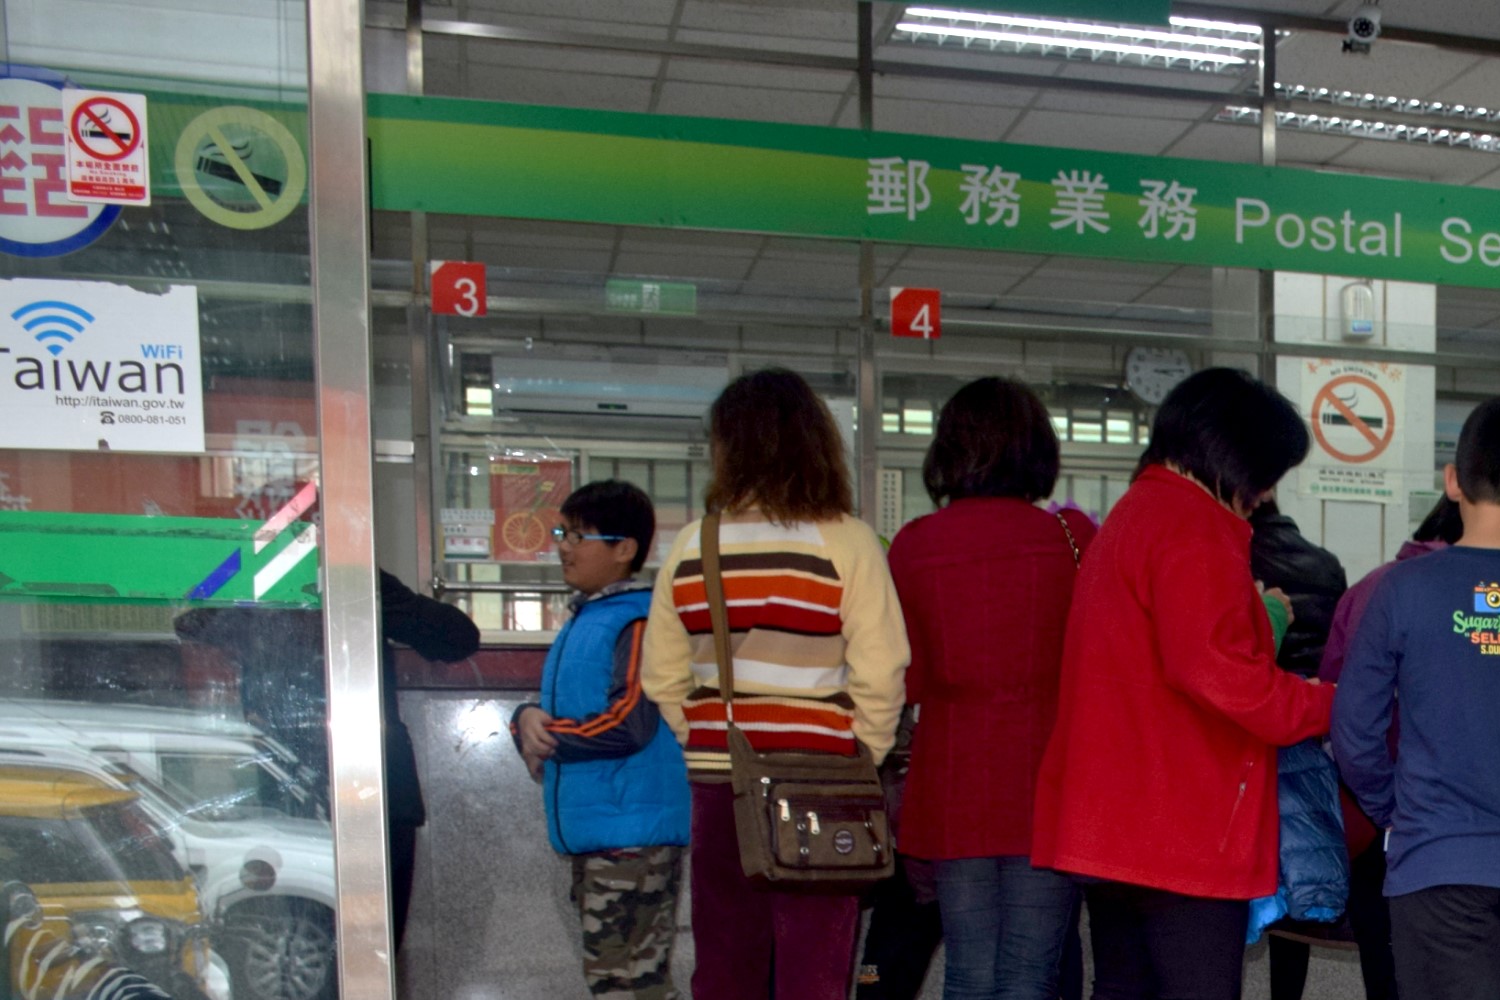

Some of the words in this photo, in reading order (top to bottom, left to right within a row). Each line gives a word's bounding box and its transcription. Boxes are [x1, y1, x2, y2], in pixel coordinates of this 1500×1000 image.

[866, 157, 1198, 241] 郵務業務
[1235, 197, 1402, 258] Postal
[454, 278, 479, 317] 3
[910, 305, 934, 339] 4
[141, 344, 183, 360] WiFi
[0, 347, 185, 394] aiwan
[55, 396, 185, 411] http://itaiwan.gov.tw
[118, 414, 187, 425] 0800-081-051
